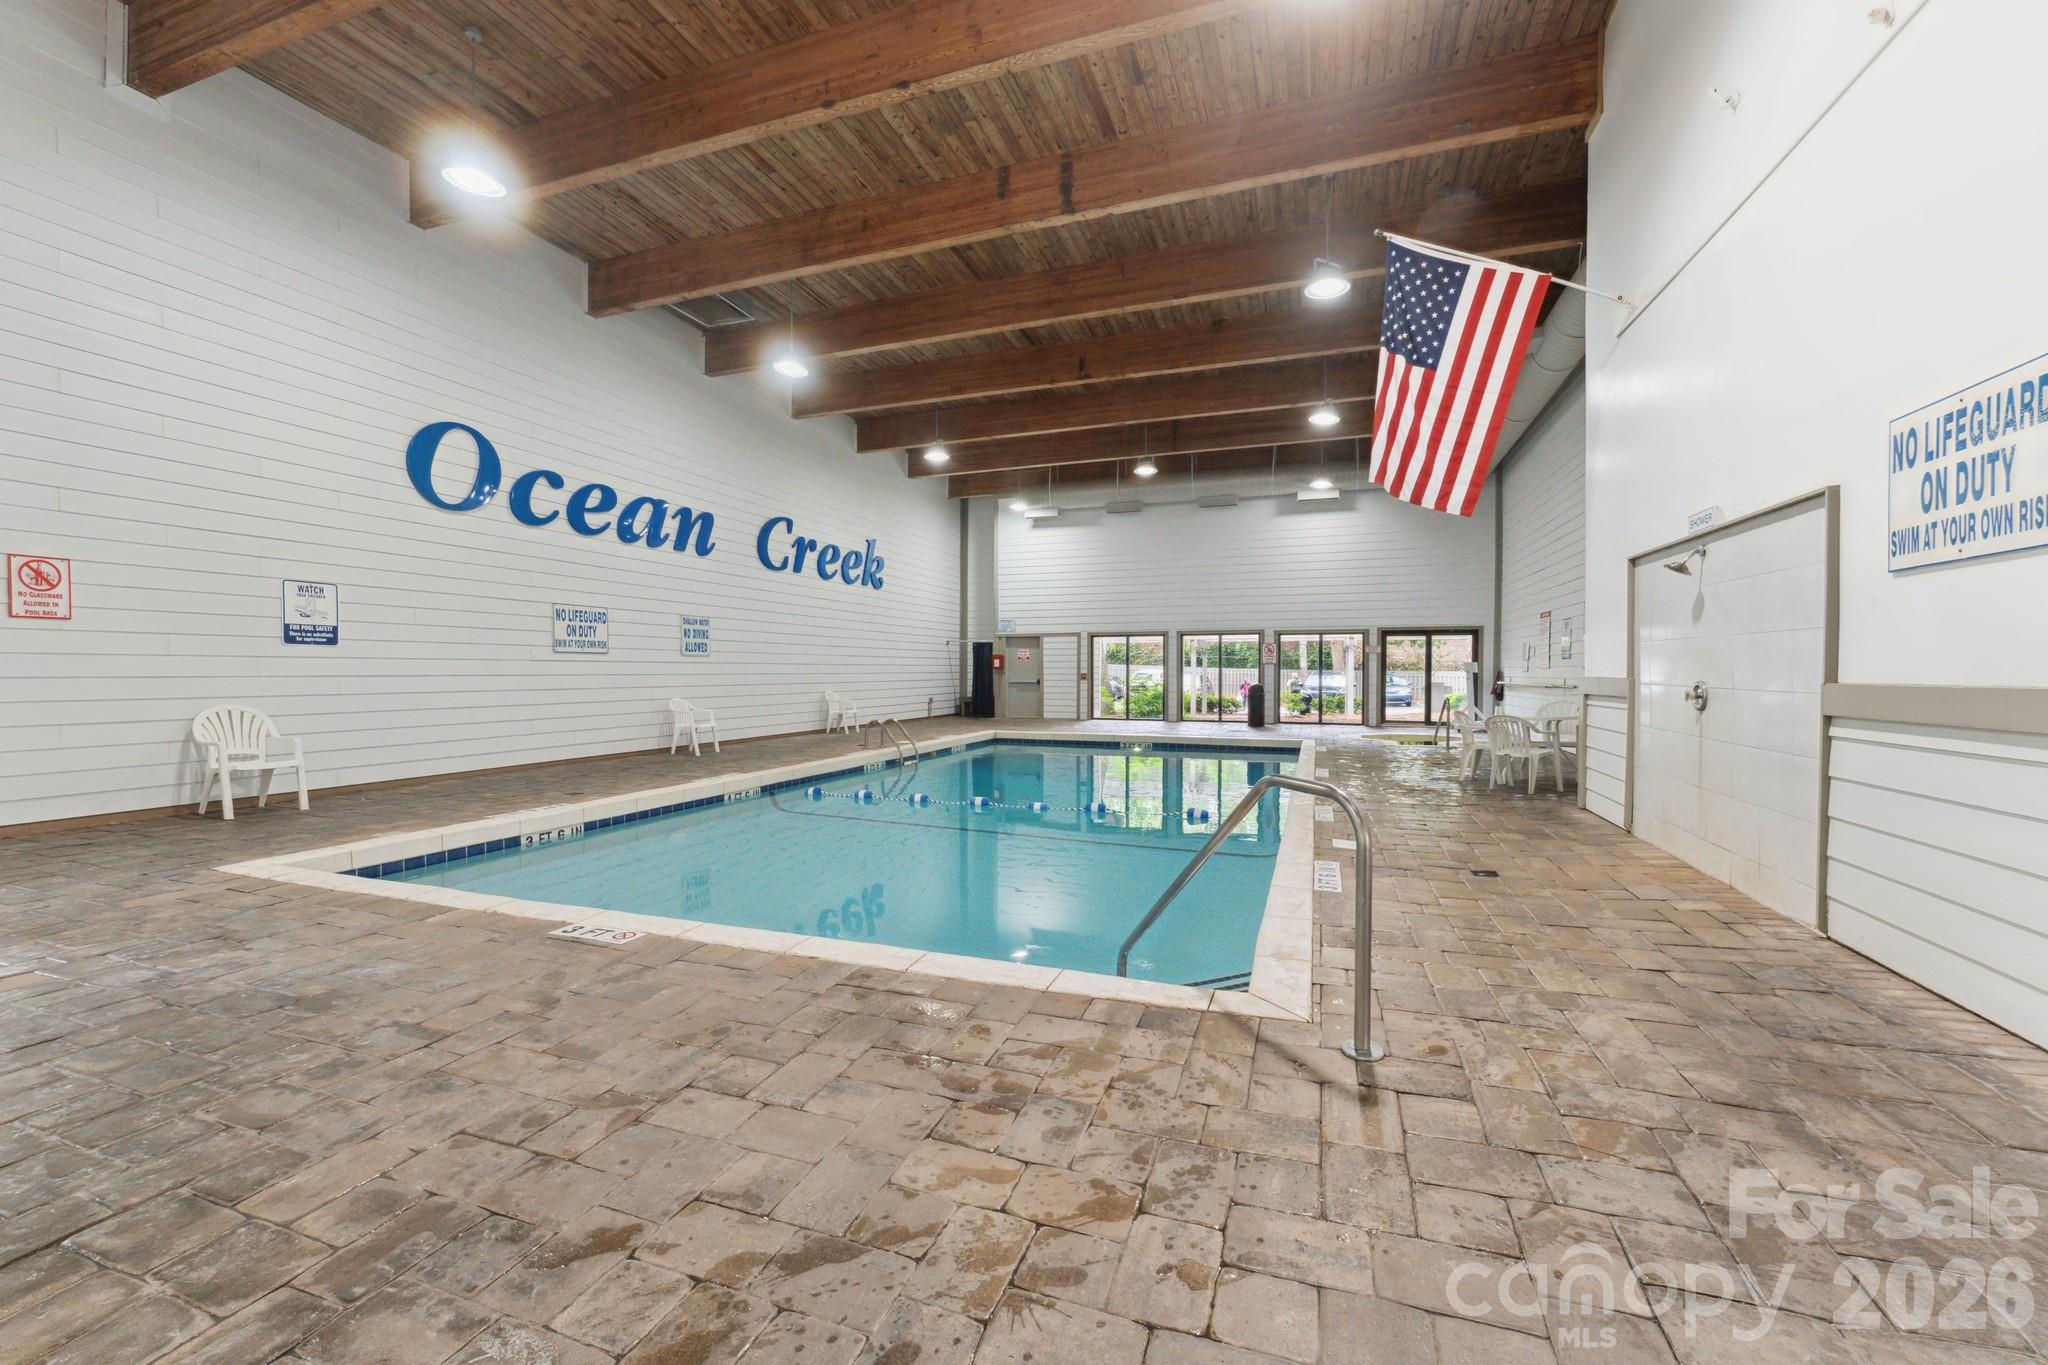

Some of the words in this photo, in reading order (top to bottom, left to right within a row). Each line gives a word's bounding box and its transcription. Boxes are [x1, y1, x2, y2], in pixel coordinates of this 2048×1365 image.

[1892, 426, 1918, 474] NO
[1920, 466, 1948, 514] ON
[1955, 444, 2017, 506] DUTY
[406, 421, 717, 557] Ocean
[756, 516, 885, 590] Creek
[1689, 512, 1712, 529] SHOWER
[1891, 524, 1920, 558] SWIM
[1923, 521, 1937, 551] AT
[1942, 511, 1976, 547] YOUR
[1981, 502, 2014, 540] OWN
[2019, 493, 2048, 533] RIS
[297, 584, 325, 595] WATCH
[555, 608, 567, 622] NO
[568, 608, 607, 624] LIFEGUARD
[566, 625, 577, 637] ON
[578, 625, 598, 638] DUTY
[555, 640, 567, 648] SWIM
[567, 640, 574, 648] AT
[574, 640, 586, 649] YOUR
[586, 640, 597, 649] OWN
[597, 640, 607, 649] RISK
[684, 641, 708, 653] ALLOWED
